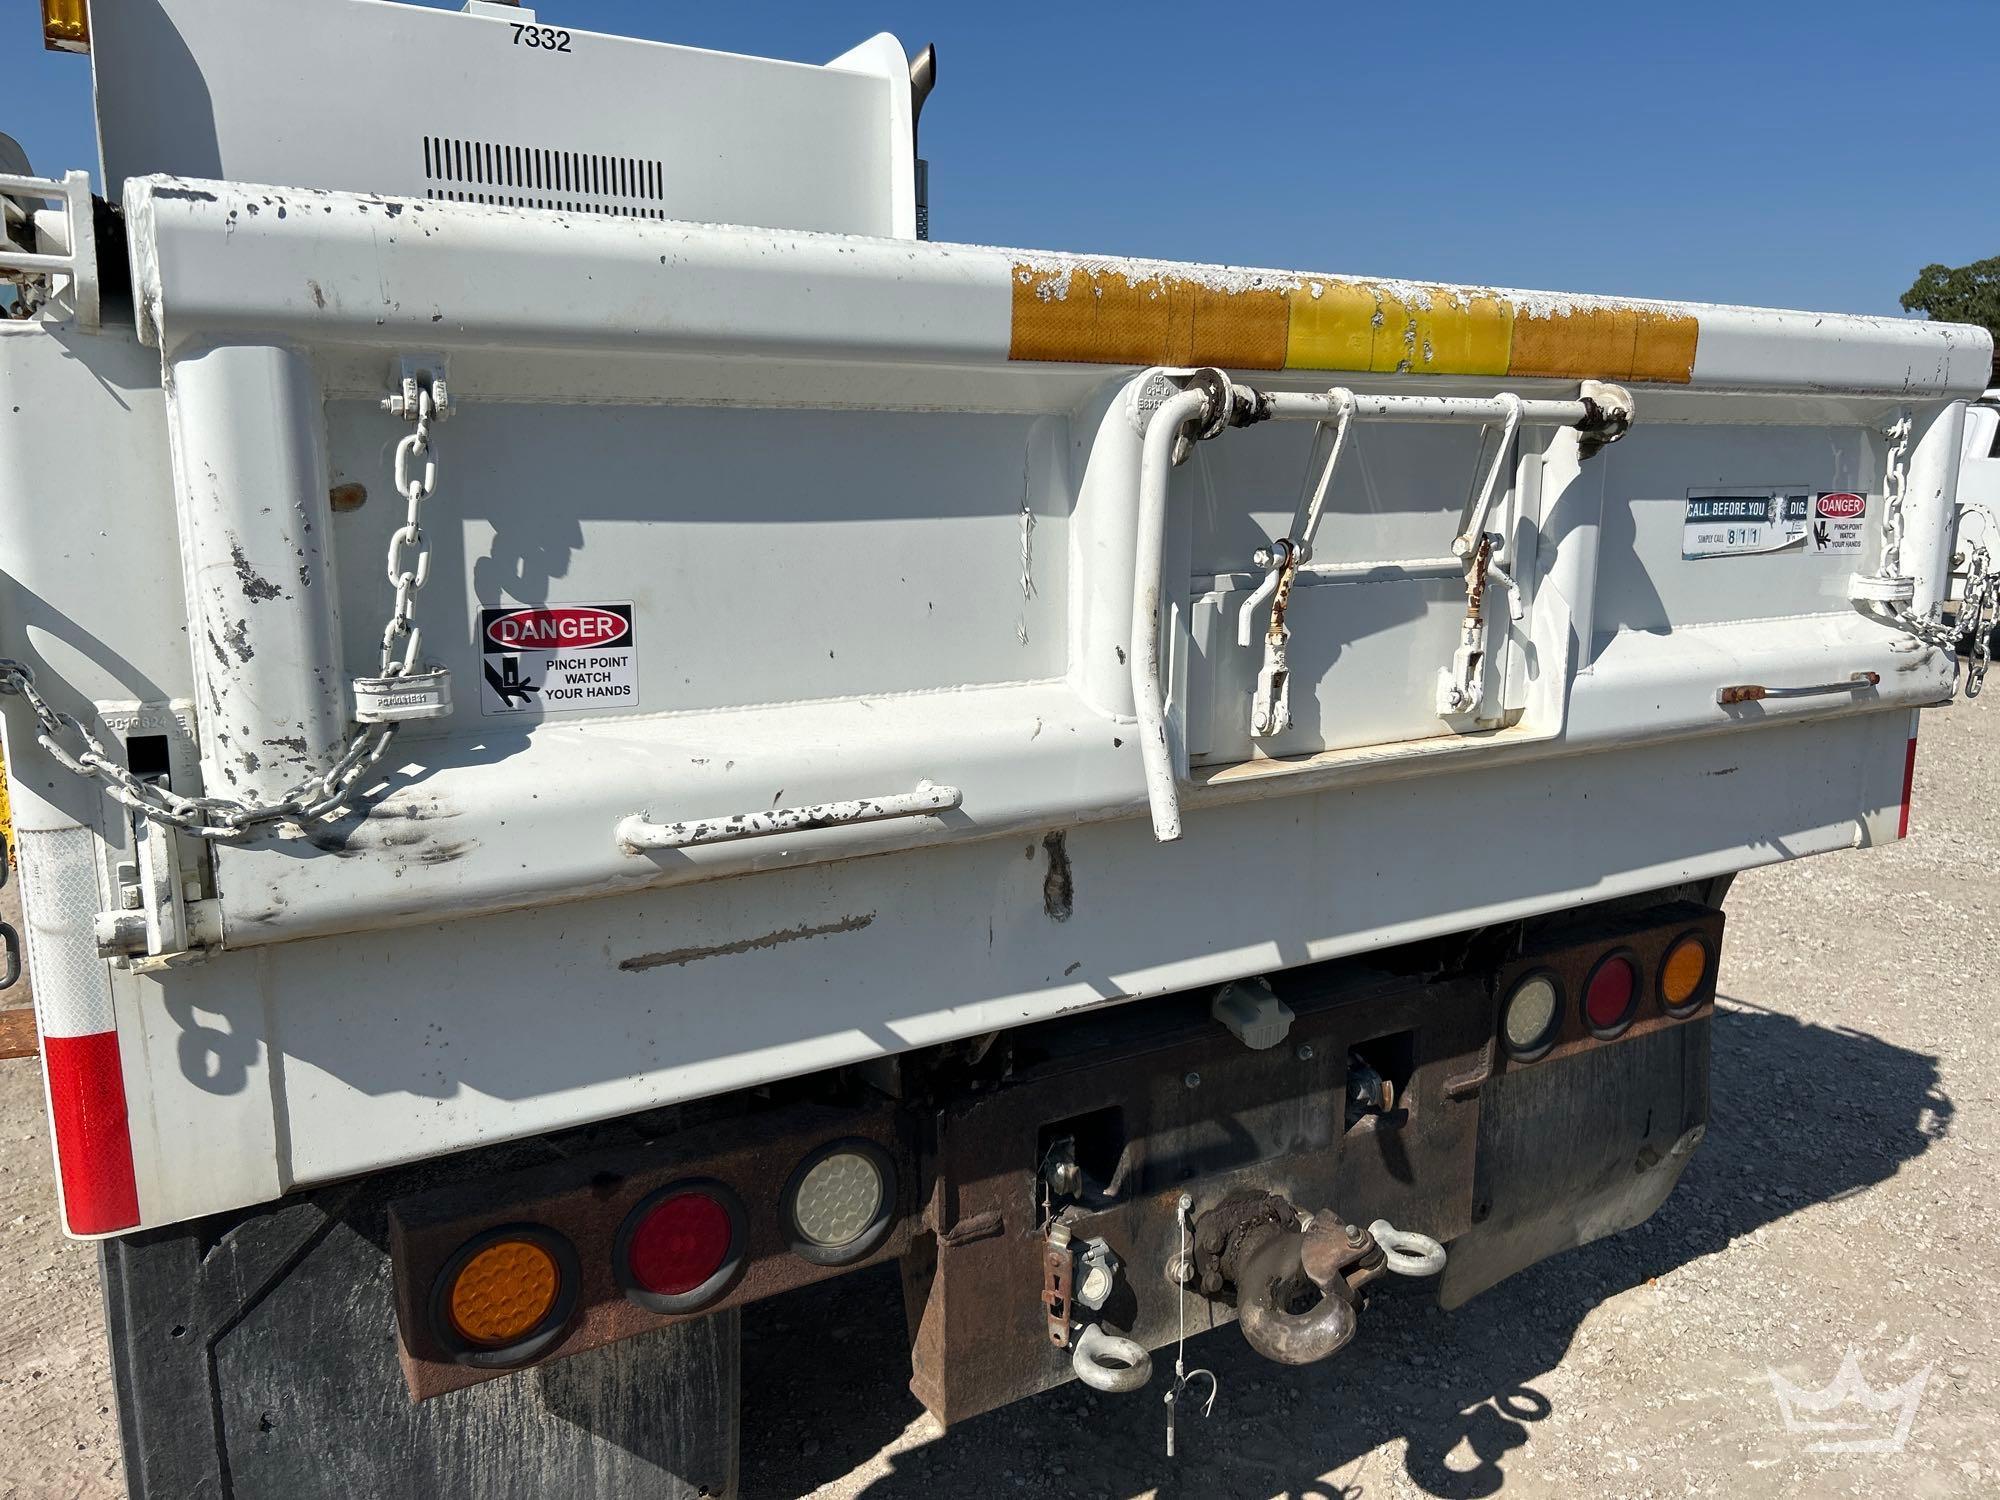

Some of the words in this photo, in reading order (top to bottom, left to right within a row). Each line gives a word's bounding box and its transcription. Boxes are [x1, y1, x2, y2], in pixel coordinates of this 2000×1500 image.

[510, 22, 571, 53] 7332
[1687, 503, 1709, 517] CALL
[1713, 502, 1745, 516] BEFORE
[1748, 502, 1765, 516] YOU
[1822, 499, 1861, 513] DANGER
[1834, 523, 1848, 531] PINCH
[1698, 534, 1712, 544] SIMPLY
[1713, 533, 1724, 544] CALL
[1846, 540, 1861, 548] HANDS
[501, 617, 615, 641] DANGER
[546, 658, 587, 671] PINCH
[590, 656, 629, 669] POINT
[565, 672, 611, 684] WATCH
[545, 688, 583, 700] YOUR
[586, 685, 631, 698] HANDS
